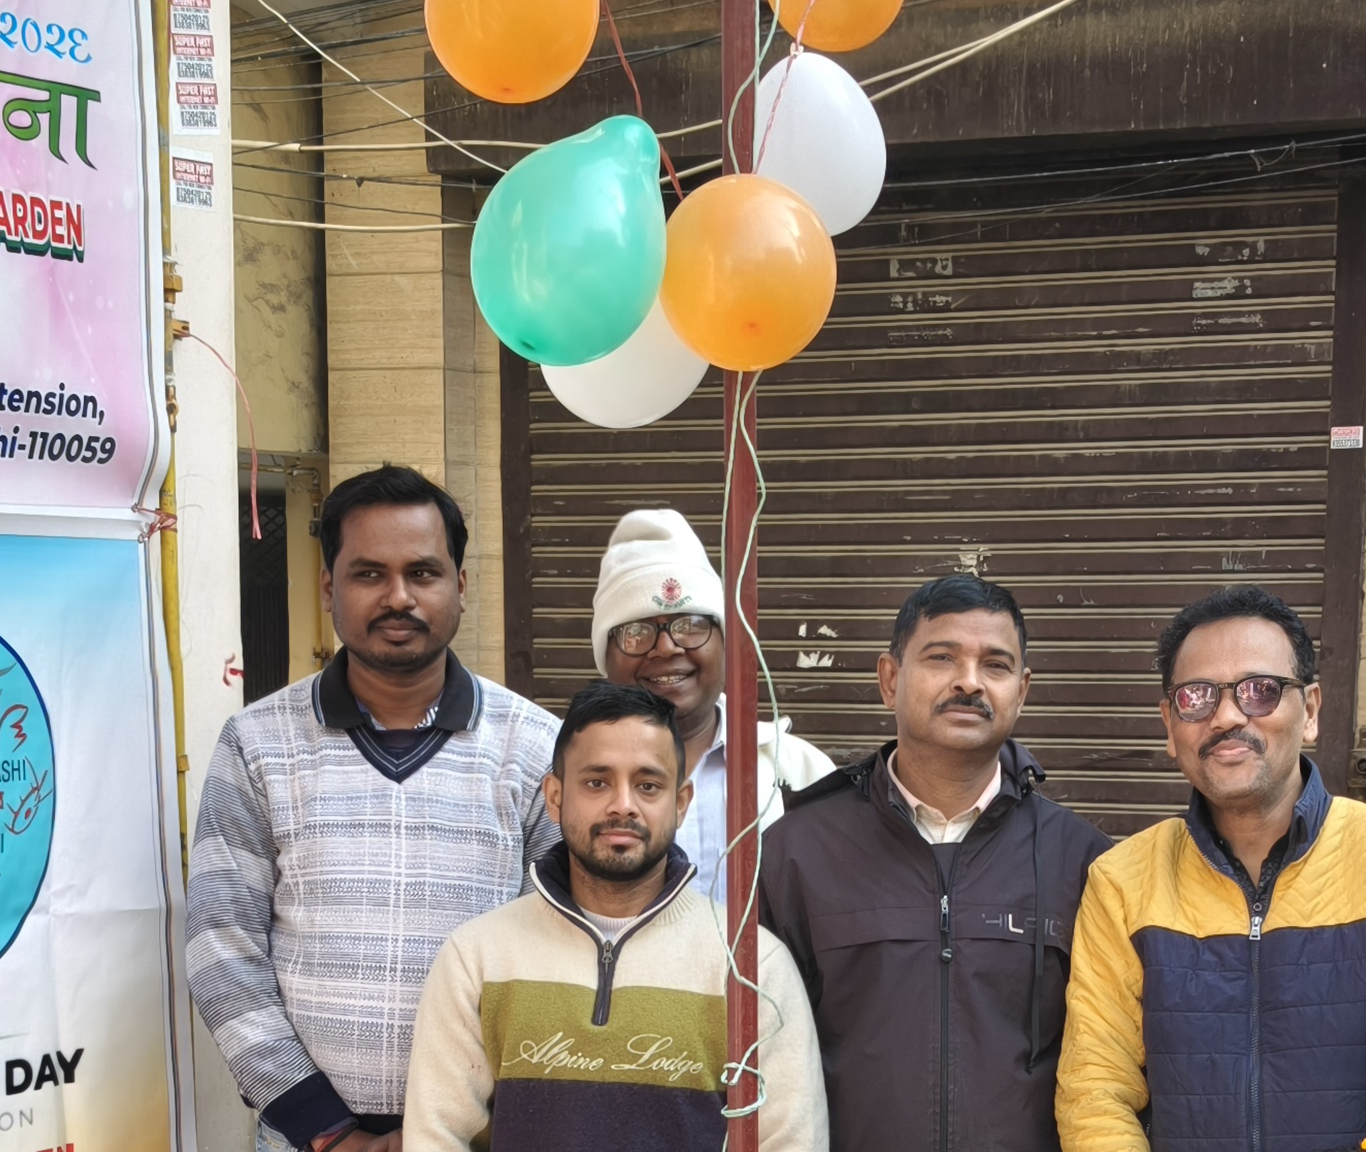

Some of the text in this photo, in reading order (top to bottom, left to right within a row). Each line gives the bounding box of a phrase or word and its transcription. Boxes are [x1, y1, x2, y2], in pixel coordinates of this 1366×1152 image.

[5, 1048, 85, 1096] DAY
[502, 1031, 703, 1081] Alpine Lodge
